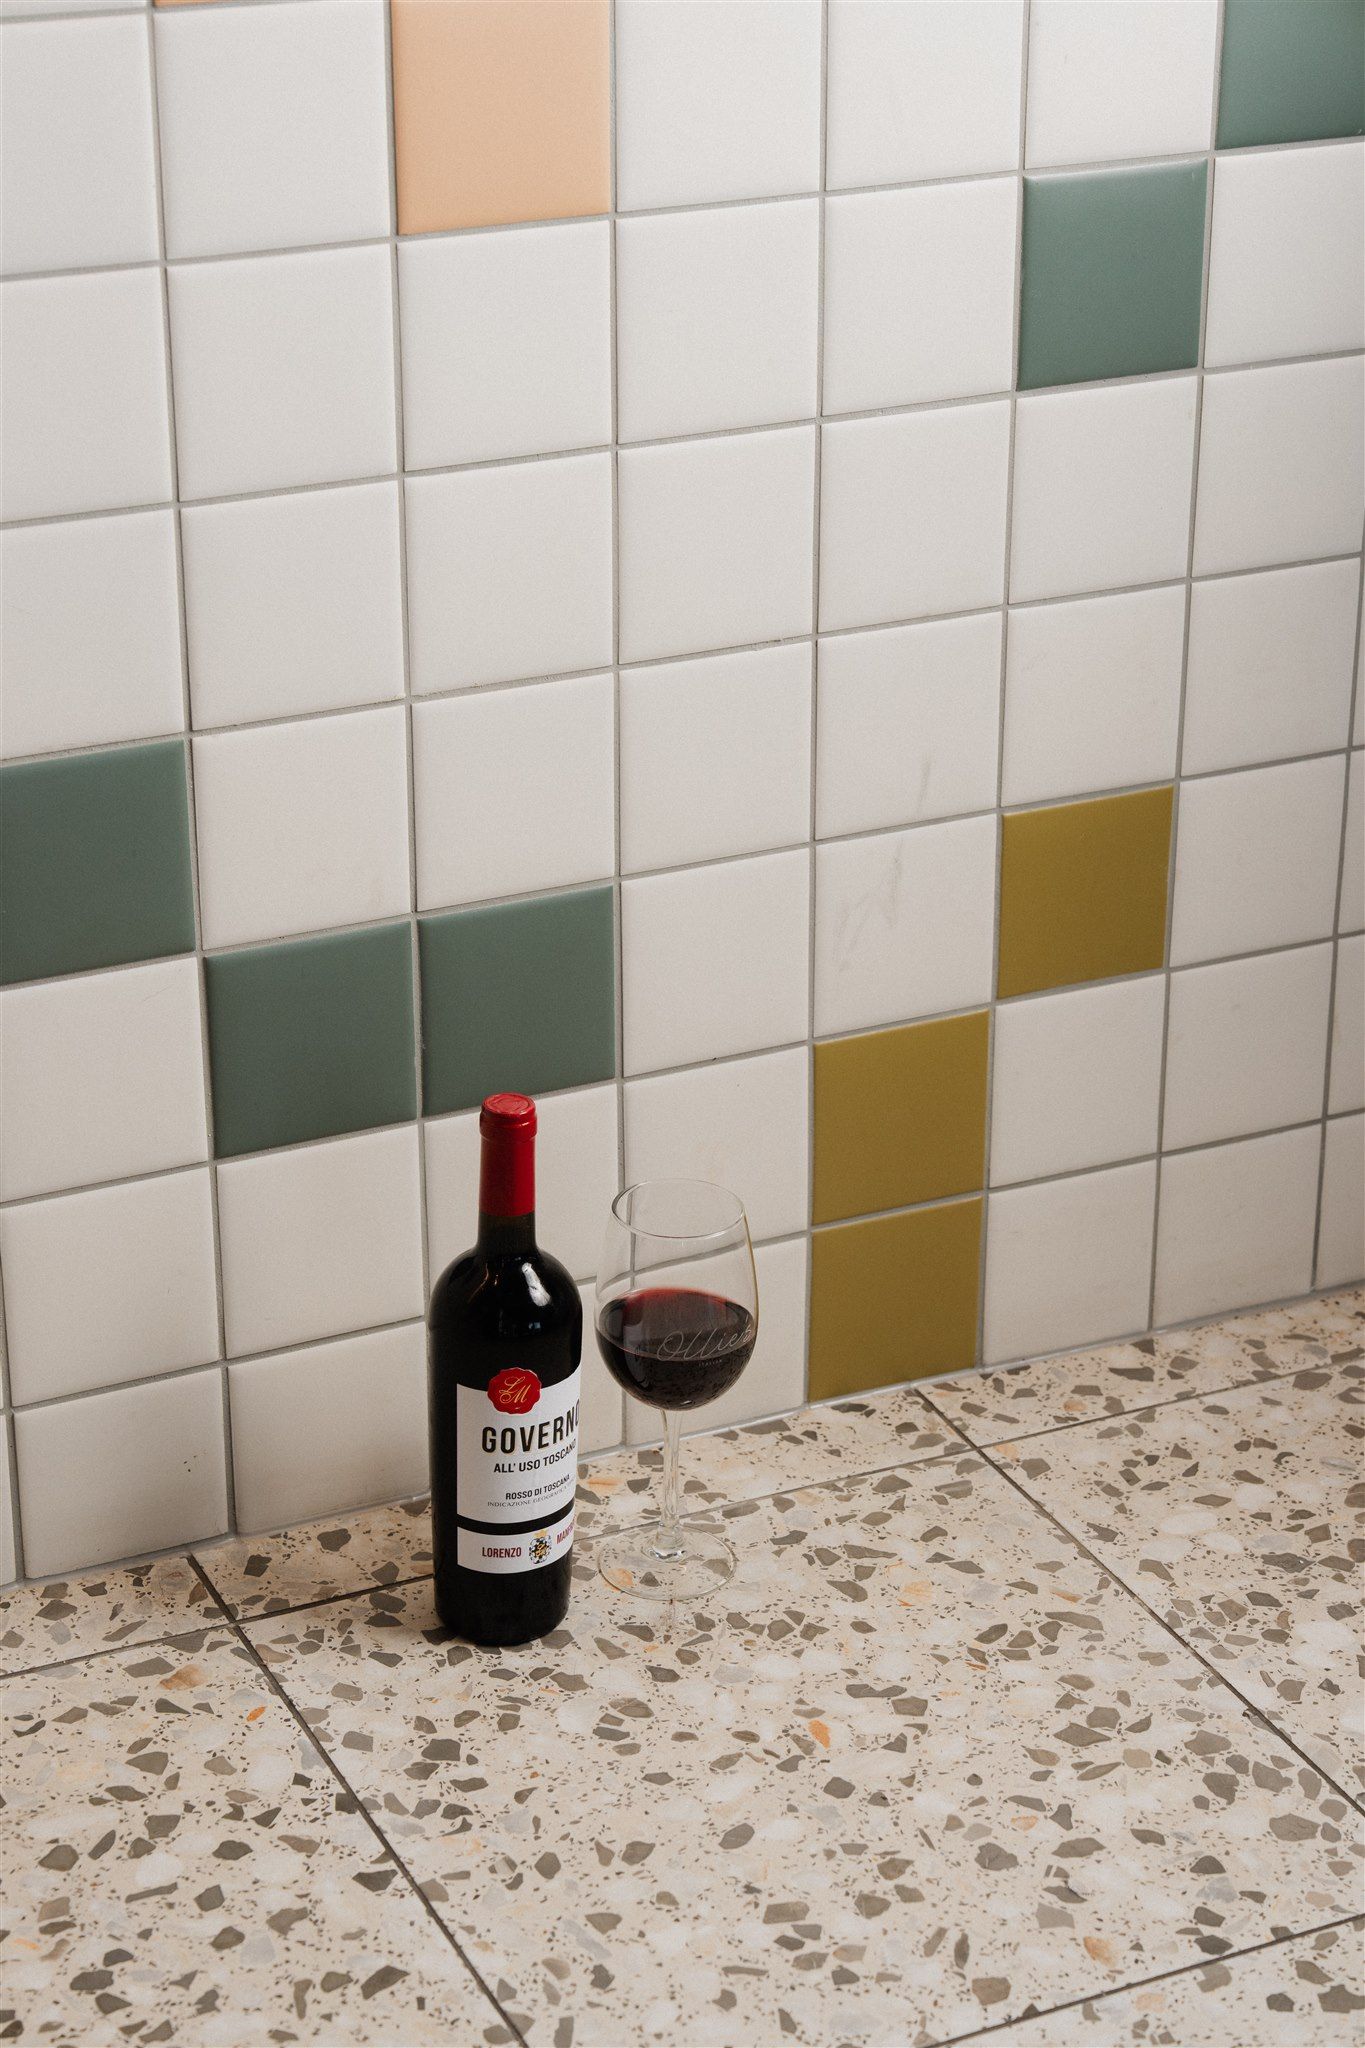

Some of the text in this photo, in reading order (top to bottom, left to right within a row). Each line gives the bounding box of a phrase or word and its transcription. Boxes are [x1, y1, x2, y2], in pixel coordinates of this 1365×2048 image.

[519, 1459, 541, 1472] USO
[505, 1490, 533, 1500] ROSSO
[534, 1488, 542, 1496] DI
[482, 1547, 522, 1558] LORENZO
